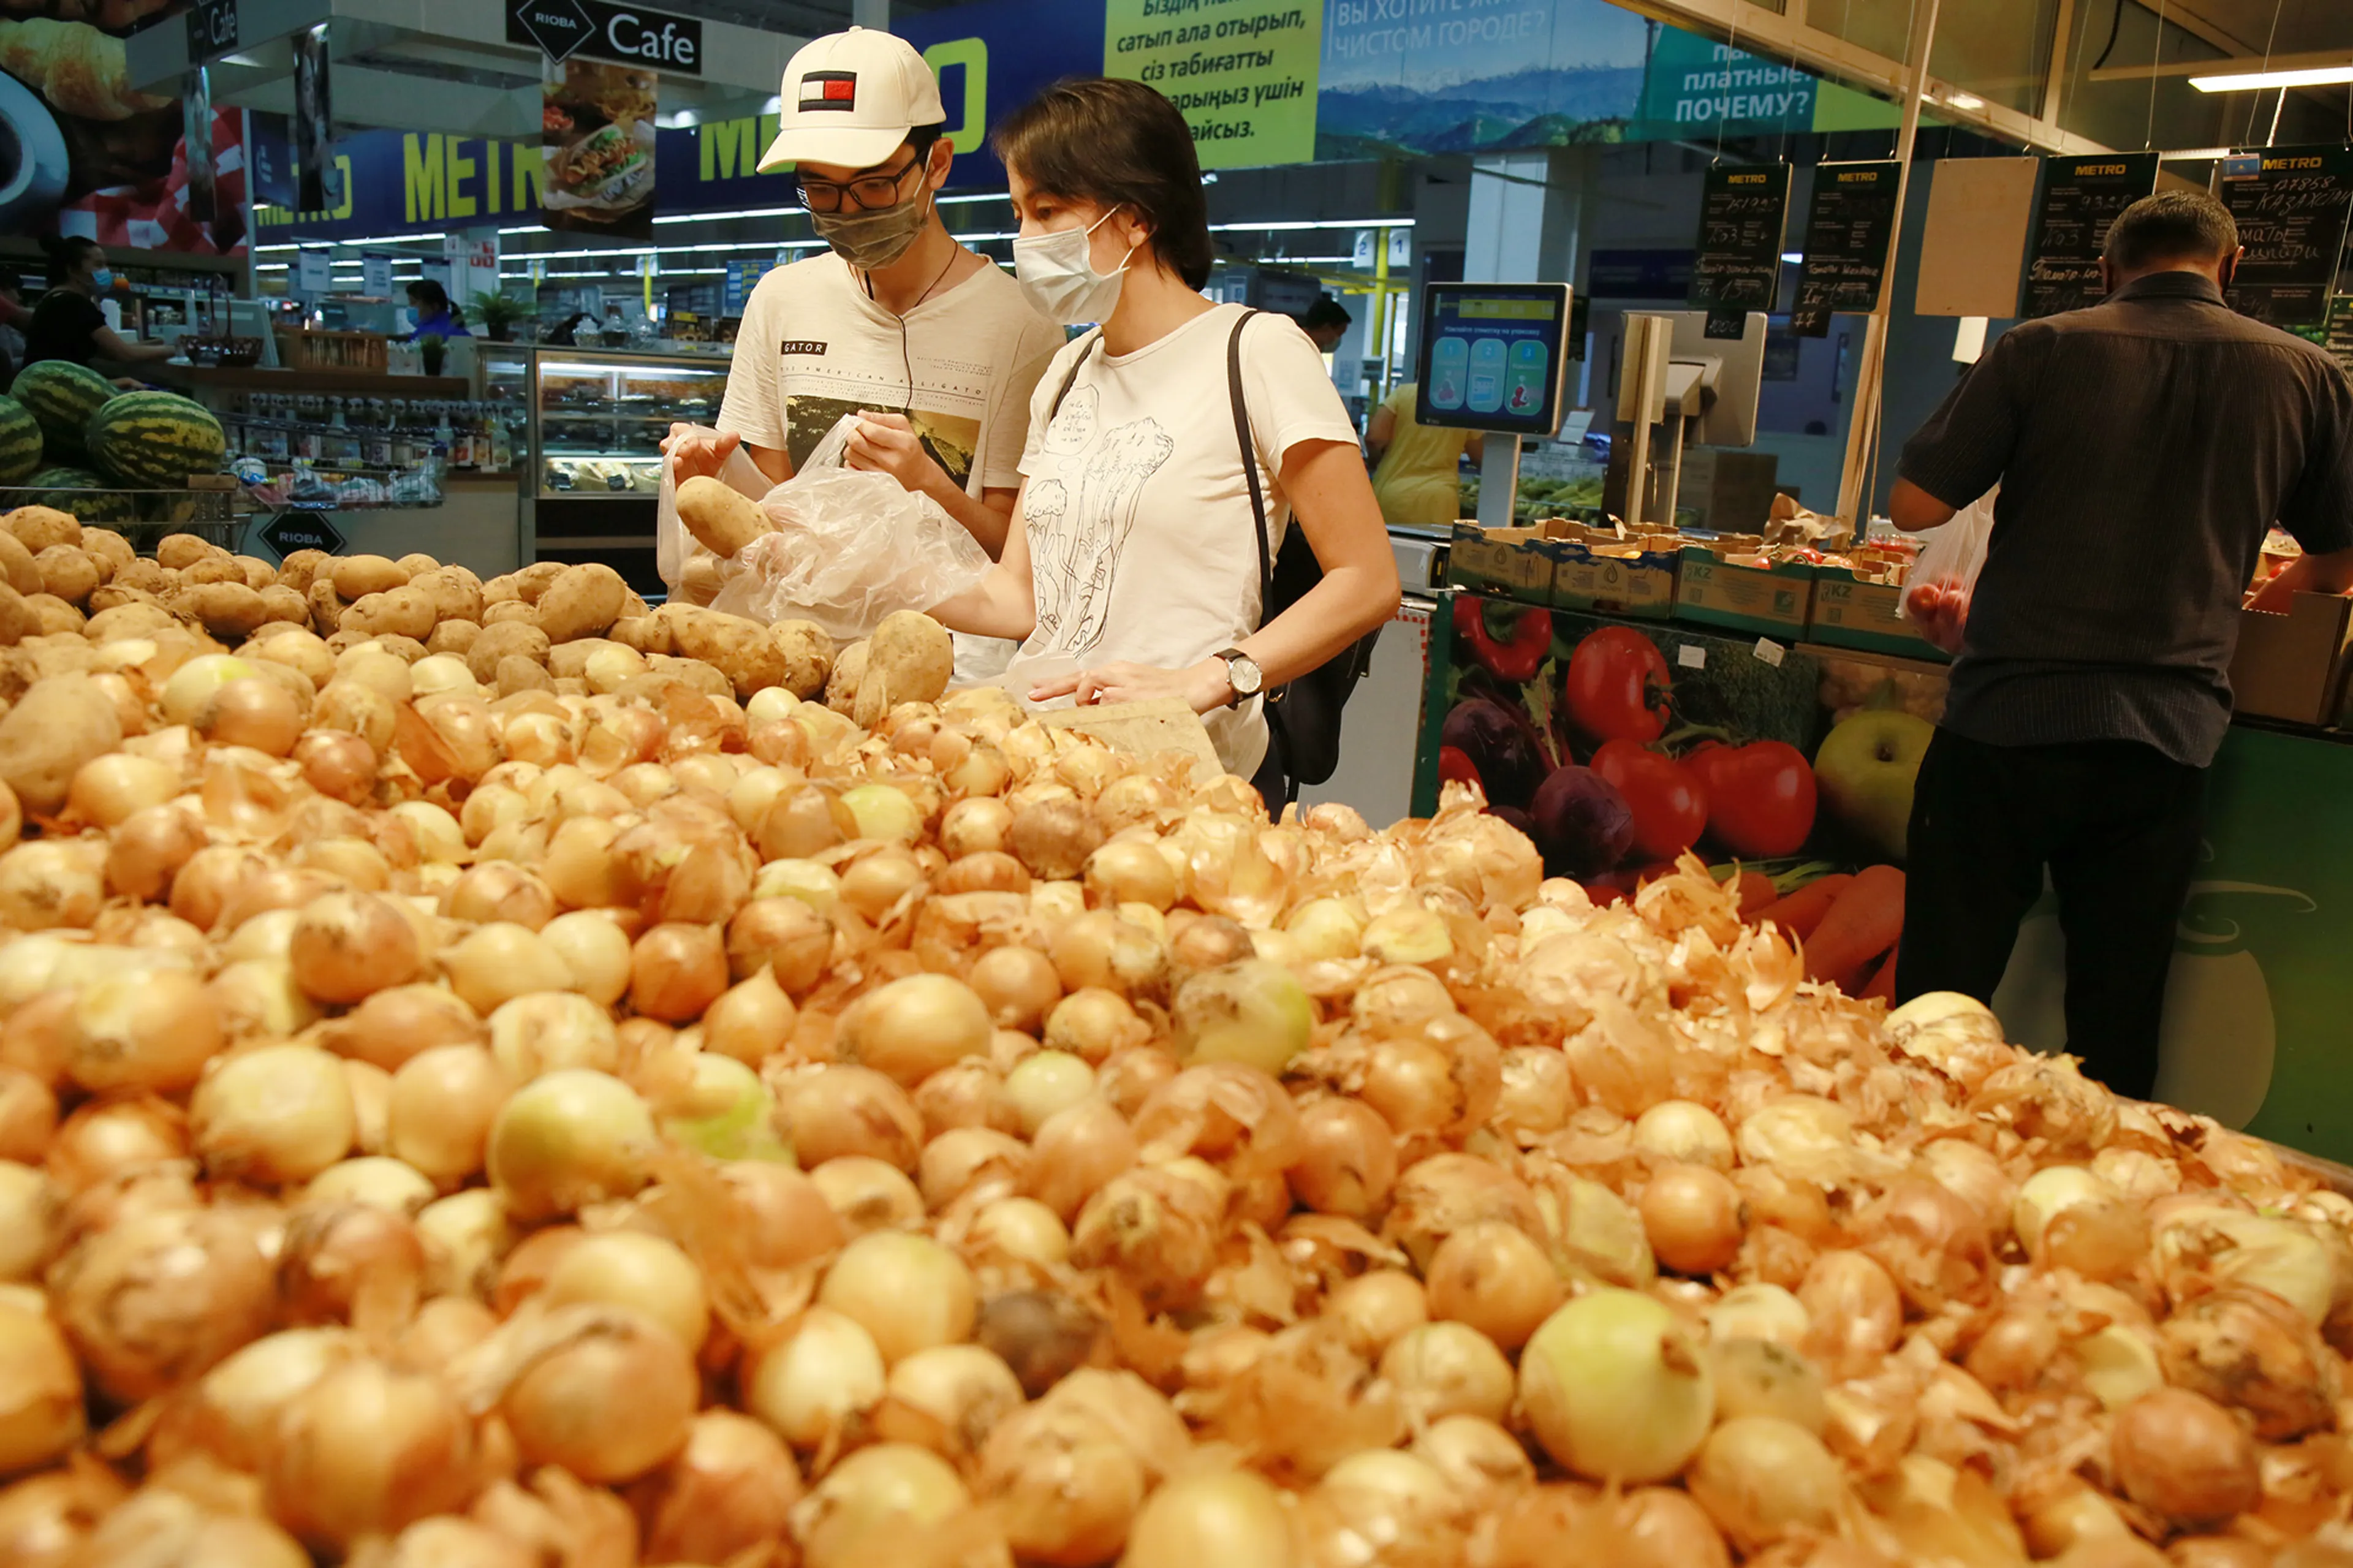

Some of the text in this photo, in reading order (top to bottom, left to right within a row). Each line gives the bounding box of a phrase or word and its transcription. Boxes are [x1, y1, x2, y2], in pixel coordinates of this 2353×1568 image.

[535, 12, 577, 29] RIOBA
[608, 13, 694, 64] Cafe
[1117, 10, 1305, 53] сатып ала отырып,
[1336, 10, 1545, 59] ЧИСТОМ ГОРОДЕ?
[1141, 48, 1274, 81] сіз табиғатты
[1255, 75, 1304, 108] үшін
[1675, 90, 1809, 122] ПОЧЕМУ?
[2075, 164, 2126, 176] METRO
[2262, 157, 2322, 171] METRO
[1728, 174, 1767, 184] METRO
[1838, 172, 1878, 183] METRO
[1359, 242, 1367, 256] 2
[1395, 240, 1403, 253] 1
[784, 343, 822, 352] GATOR
[806, 366, 884, 381] AMERICAN
[279, 532, 324, 545] RIOBA
